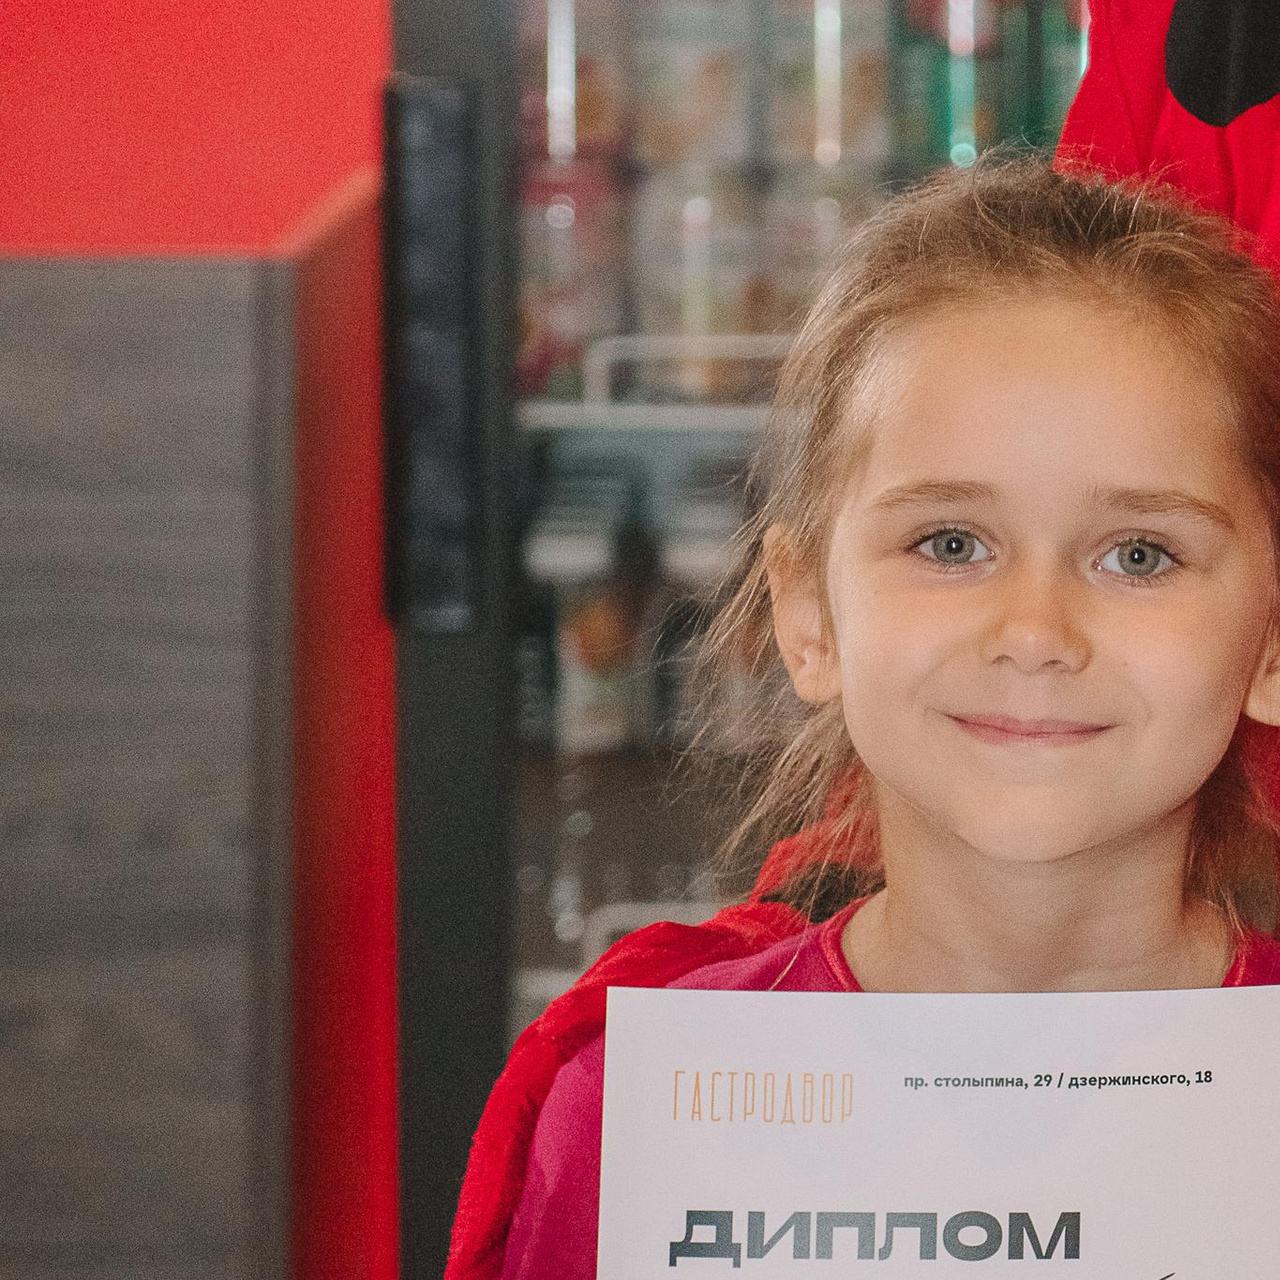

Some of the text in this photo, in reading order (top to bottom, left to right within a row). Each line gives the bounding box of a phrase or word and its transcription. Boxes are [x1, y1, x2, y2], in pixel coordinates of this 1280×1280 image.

[673, 1070, 853, 1125] ГАСТРОДВОР
[904, 1070, 1213, 1090] пр. столыпина, 29 / дзержинского, 18
